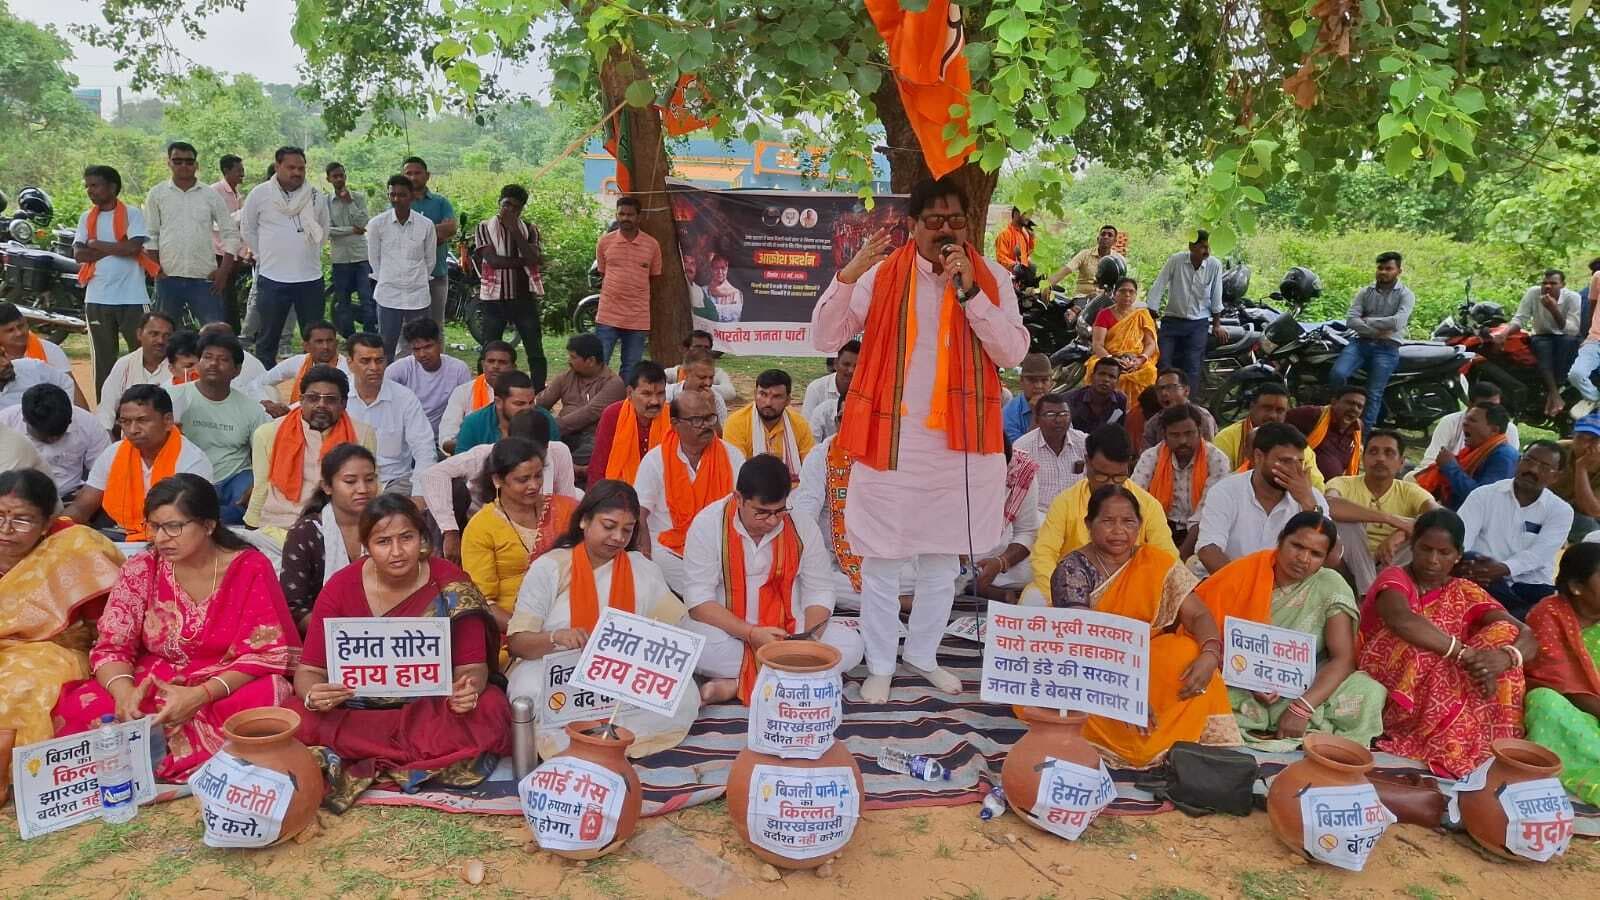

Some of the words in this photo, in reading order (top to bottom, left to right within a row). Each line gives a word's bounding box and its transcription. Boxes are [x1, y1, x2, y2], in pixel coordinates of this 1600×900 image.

[713, 327, 751, 343] भारतीय
[754, 328, 782, 342] जनता
[994, 614, 1023, 631] सत्ता
[1027, 615, 1048, 633] की
[1051, 618, 1083, 639] भूखी
[1087, 623, 1134, 644] सरकार
[336, 630, 385, 660] हेमंत
[390, 629, 441, 658] सोरेन
[598, 621, 643, 657] हेमंत
[643, 636, 691, 673] सोरेन
[1030, 639, 1065, 654] तरफ
[1068, 642, 1128, 664] हाहाकार
[1231, 628, 1270, 655] बिजली
[1272, 639, 1310, 663] कटौती
[340, 664, 388, 690] हाय
[393, 663, 441, 687] हाय
[587, 654, 633, 686] हाय
[631, 666, 678, 700] हाय
[994, 656, 1028, 673] लाठी
[1033, 658, 1053, 675] डंडे
[1056, 660, 1078, 678] की
[1083, 665, 1130, 688] सरकार
[1253, 660, 1275, 682] बंद
[573, 688, 595, 708] बंद
[775, 681, 810, 700] बिजली
[814, 681, 834, 699] पानी
[987, 677, 1027, 695] जनता
[1030, 678, 1042, 698] है
[1045, 680, 1082, 701] बेबस
[778, 702, 832, 720] किल्लत
[766, 716, 836, 733] झारखंडवासी
[45, 740, 91, 766] बिजली
[39, 777, 99, 805] झारखंड
[531, 767, 574, 795] रसोई
[573, 774, 610, 804] गैस
[775, 780, 813, 798] बिजली
[815, 780, 838, 798] पानी
[1051, 775, 1093, 806] हेमंत
[36, 800, 78, 820] बर्दाश्त
[226, 783, 277, 816] कटौती
[779, 800, 836, 819] किल्लत
[1515, 792, 1561, 817] झारखंड
[767, 815, 842, 832] झारखंडवासी
[1047, 806, 1088, 827] हाय
[1315, 801, 1362, 828] बिजली
